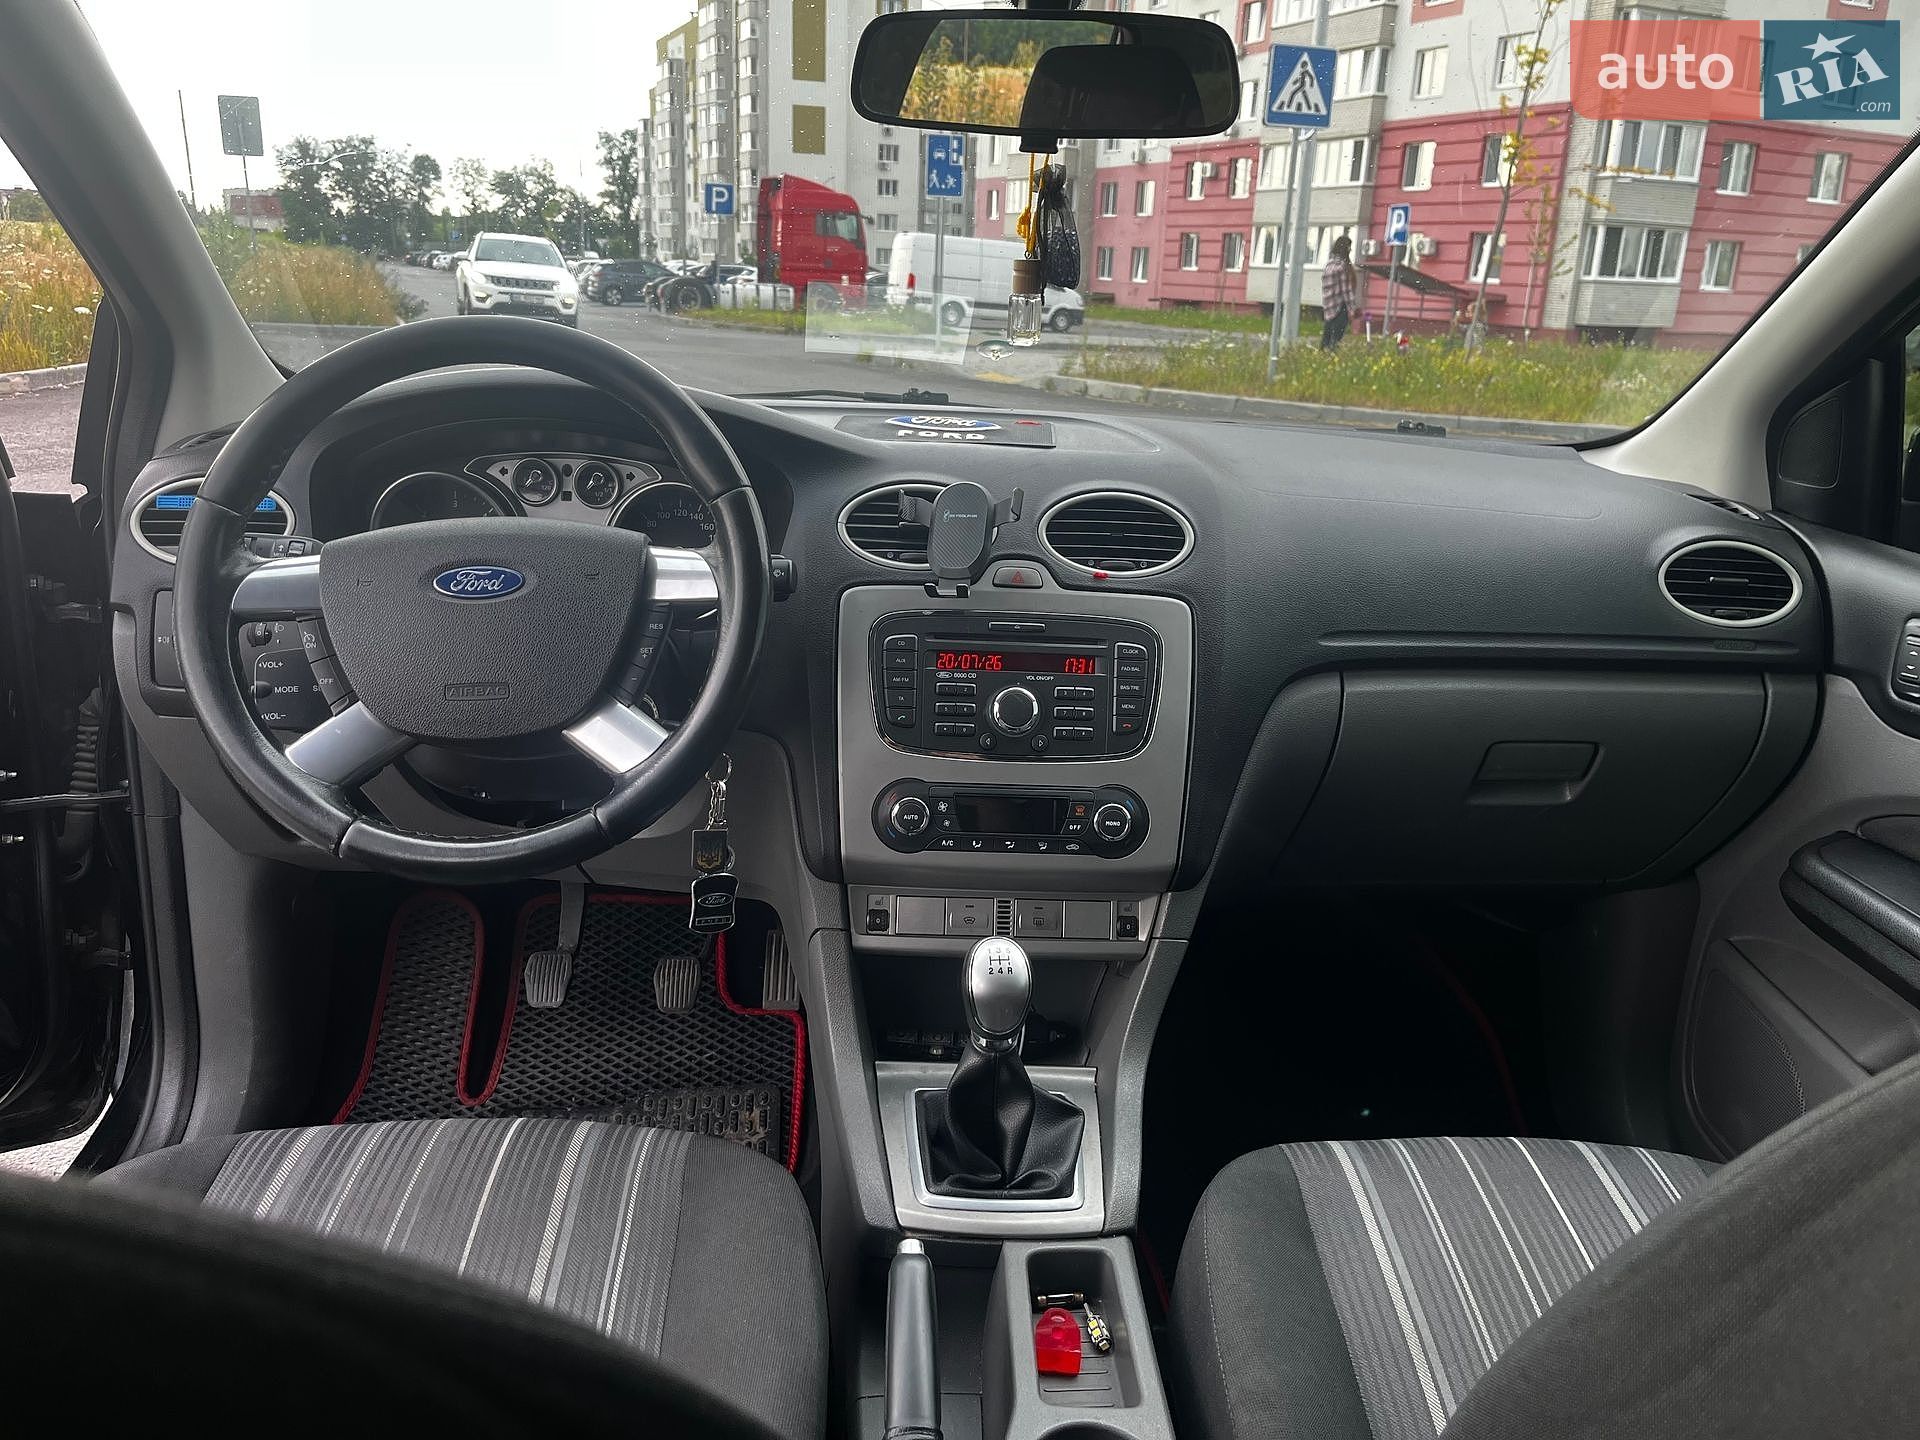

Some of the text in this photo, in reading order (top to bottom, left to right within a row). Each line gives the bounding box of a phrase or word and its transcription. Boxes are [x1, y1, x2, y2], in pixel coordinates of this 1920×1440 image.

[711, 187, 729, 211] P
[1390, 209, 1405, 240] P
[910, 415, 977, 426] Ford
[897, 429, 986, 440] FORD
[657, 511, 671, 520] 100
[673, 508, 688, 517] 120
[689, 512, 704, 521] 140
[700, 522, 715, 531] 160
[450, 570, 505, 591] Ford
[261, 660, 285, 669] VOL+
[937, 653, 1002, 669] 20/07/26
[1064, 657, 1093, 674] 17:31
[319, 677, 334, 685] OFF
[274, 685, 300, 693] MODE
[448, 685, 508, 698] AIRBAG
[264, 712, 287, 720] VOL-
[941, 839, 954, 847] A/C
[988, 966, 1014, 975] 2 4 R
